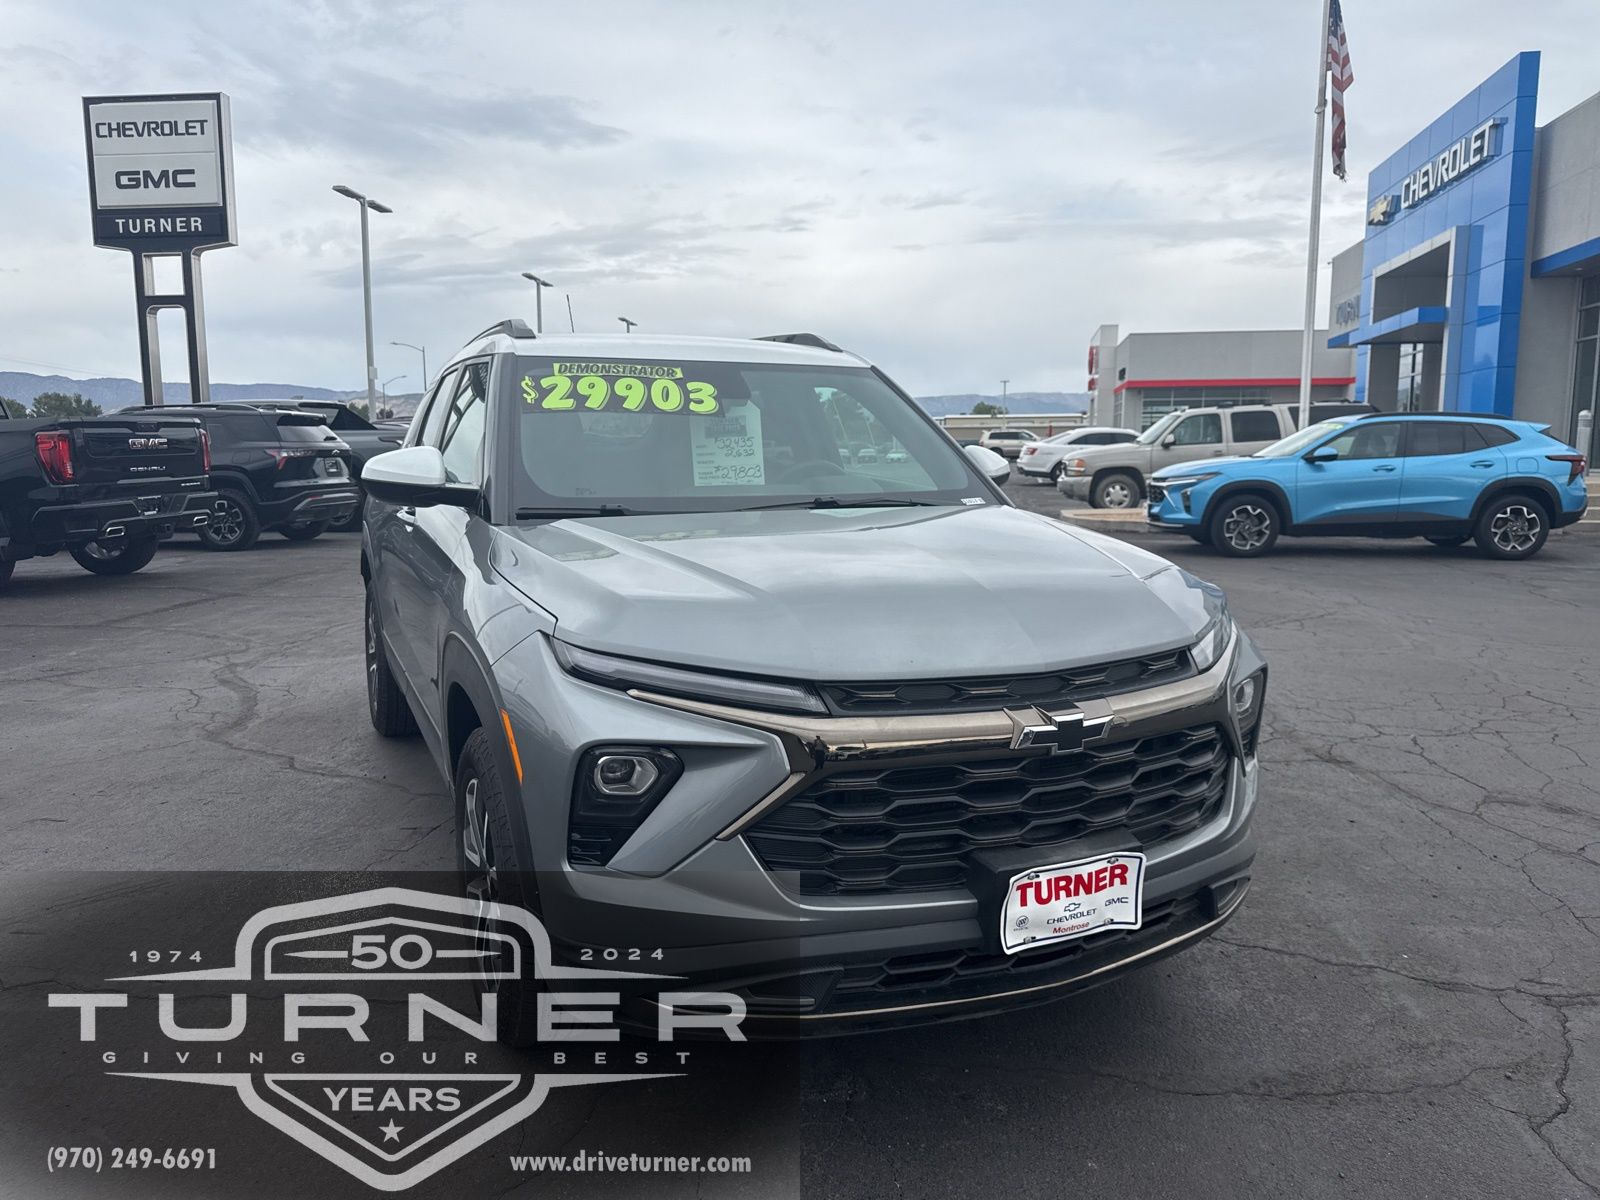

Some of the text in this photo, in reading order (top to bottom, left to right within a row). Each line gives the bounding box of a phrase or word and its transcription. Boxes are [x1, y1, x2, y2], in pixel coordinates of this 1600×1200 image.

[95, 119, 208, 138] CHEVROLET
[1401, 117, 1506, 210] CHEVROLET
[115, 169, 196, 189] GMC
[116, 217, 203, 233] TURNER
[557, 362, 677, 378] DEMONSTRATOR
[521, 375, 719, 414] $29903
[129, 438, 169, 450] GMC
[1016, 863, 1128, 907] TURNER
[1105, 896, 1129, 907] GMC
[1047, 908, 1097, 925] CHEVROLET
[1052, 921, 1090, 934] Montrose
